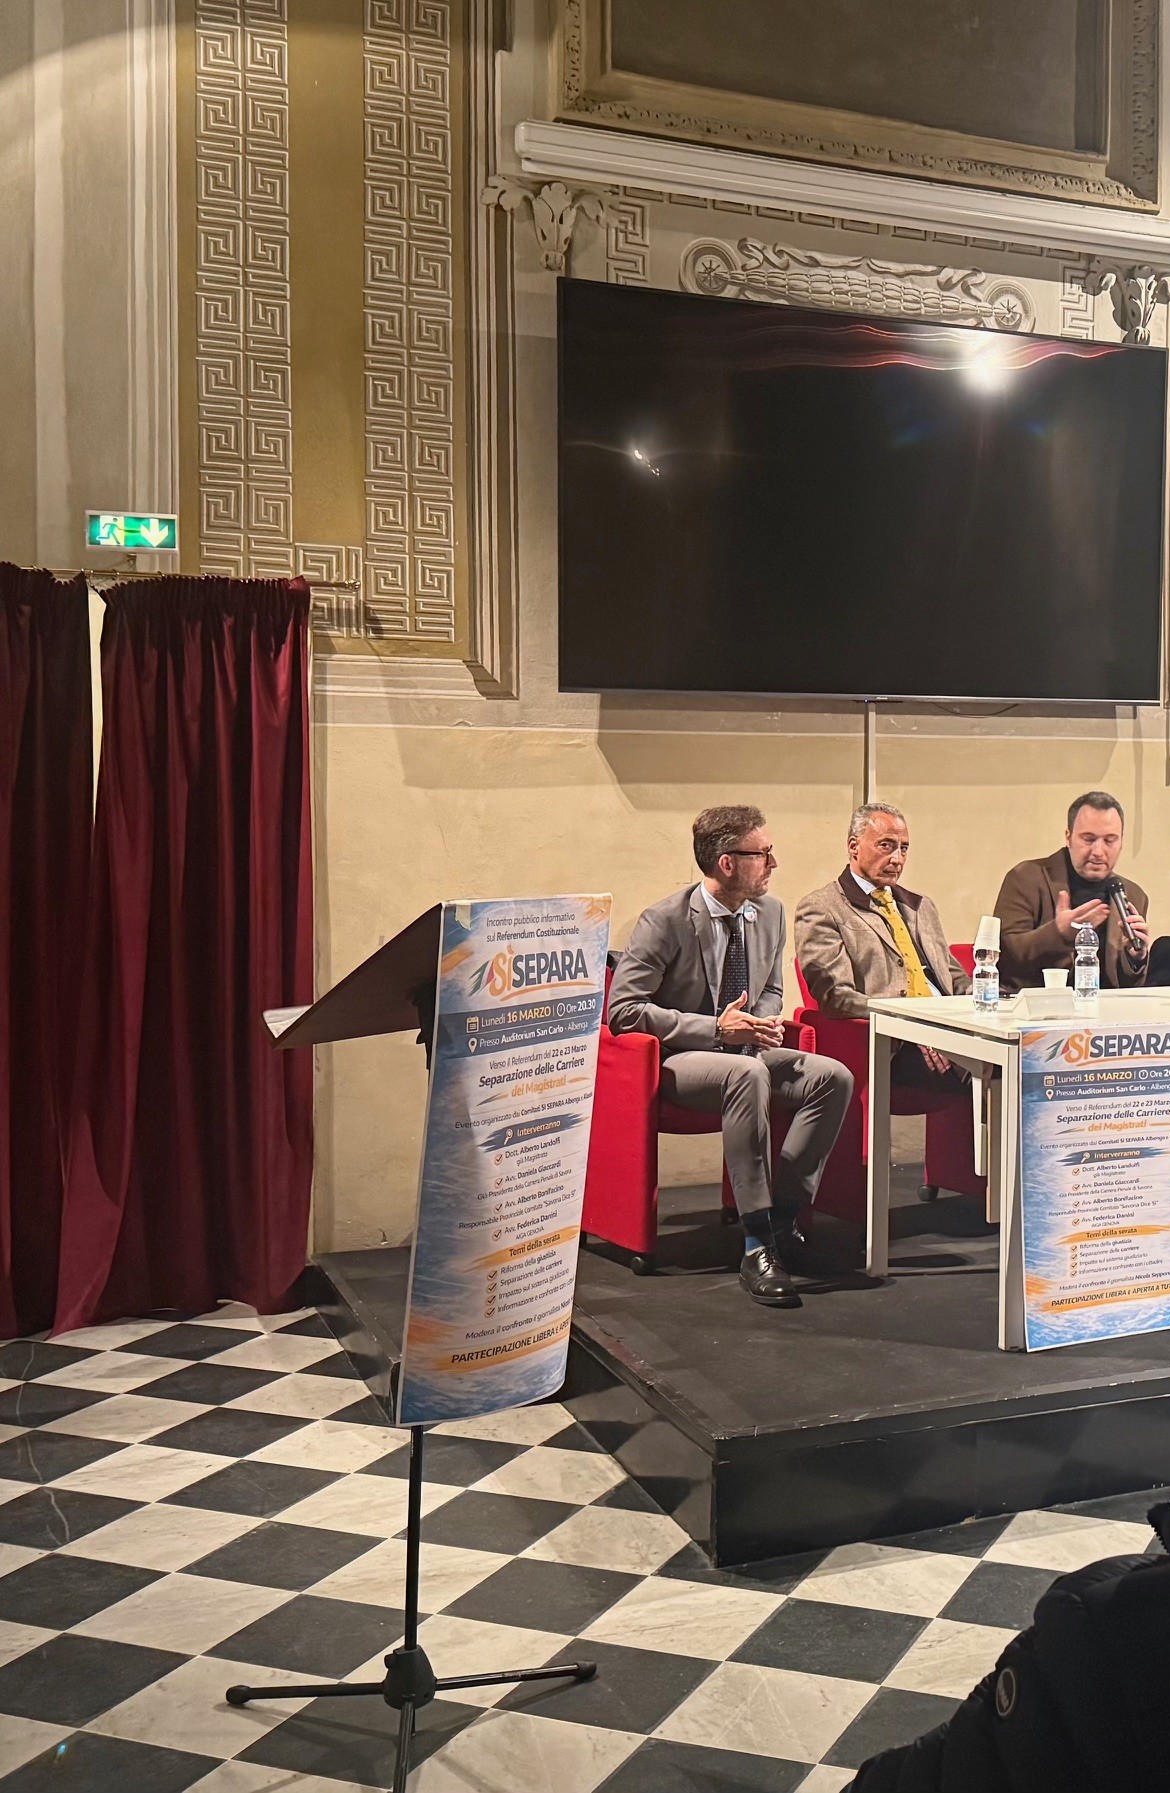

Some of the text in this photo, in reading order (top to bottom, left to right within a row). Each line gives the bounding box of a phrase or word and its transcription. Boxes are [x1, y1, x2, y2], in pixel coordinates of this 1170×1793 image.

[487, 913, 575, 927] Incontro pubblico informativo
[487, 926, 579, 942] sul Referendum Costituzionale
[507, 1012, 517, 1022] 16
[519, 1006, 550, 1021] MARZO
[566, 1004, 577, 1013] Ore
[578, 999, 596, 1011] 20.30
[480, 1020, 588, 1047] Presso Auditorium San Carlo Albenga
[490, 1060, 506, 1070] Verso
[512, 1053, 542, 1066] Referendum
[552, 1049, 558, 1057] 22
[565, 1047, 571, 1055] 23
[572, 1044, 587, 1054] Marzo
[479, 1057, 584, 1088] Separazione delle Carriere
[1084, 1074, 1094, 1082] 16
[1097, 1071, 1132, 1081] MARZO
[1150, 1070, 1162, 1078] Ore
[512, 1075, 566, 1097] dei Magistrati
[1077, 1086, 1114, 1095] Auditorium
[1056, 1108, 1170, 1125] Separazione delle Carriere
[517, 1120, 560, 1137] Interverranno
[1088, 1120, 1146, 1132] dei Magistrati
[520, 1143, 540, 1154] Alberto
[1094, 1150, 1140, 1159] Interverranno
[518, 1168, 537, 1179] Daniela
[1102, 1229, 1117, 1237] della
[509, 1233, 560, 1257] Temi della serata
[1051, 1292, 1104, 1307] PARTECIPAZIONE
[1106, 1289, 1126, 1299] LIBERA
[1133, 1285, 1154, 1295] APERTA
[466, 1327, 494, 1339] Modera
[502, 1318, 532, 1332] confronto
[452, 1336, 532, 1363] PARTECIPAZIONE
[533, 1329, 555, 1342] LIBERA
